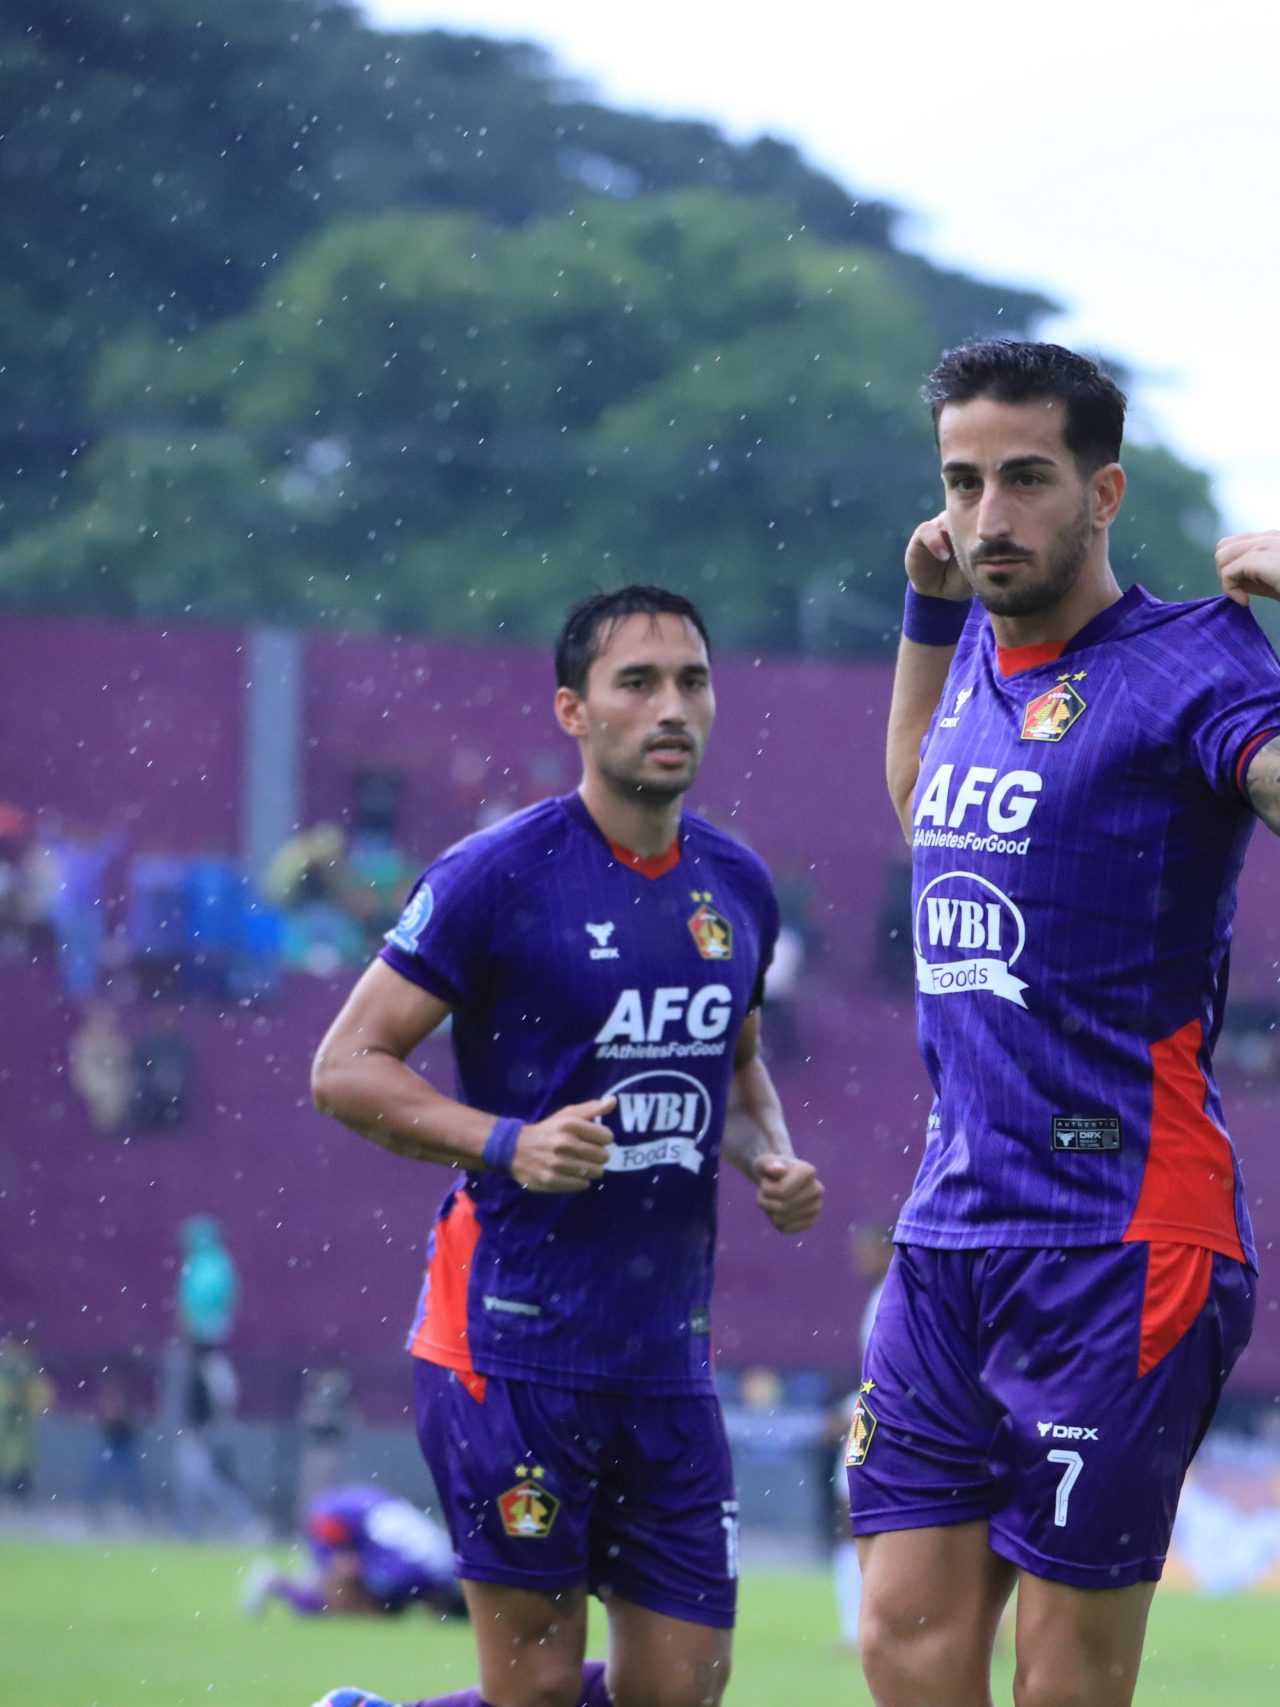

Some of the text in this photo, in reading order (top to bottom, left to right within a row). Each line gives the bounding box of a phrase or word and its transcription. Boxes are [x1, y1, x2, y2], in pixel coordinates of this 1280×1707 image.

[913, 763, 1043, 833] AFG
[926, 897, 1002, 951] WBI
[931, 963, 988, 990] Foods
[594, 984, 732, 1044] AFG
[596, 1040, 726, 1059] #AthletesForGood
[619, 1093, 699, 1133] WBI
[623, 1142, 681, 1168] Foods
[1052, 1425, 1099, 1440] DRX
[1047, 1449, 1084, 1527] 7
